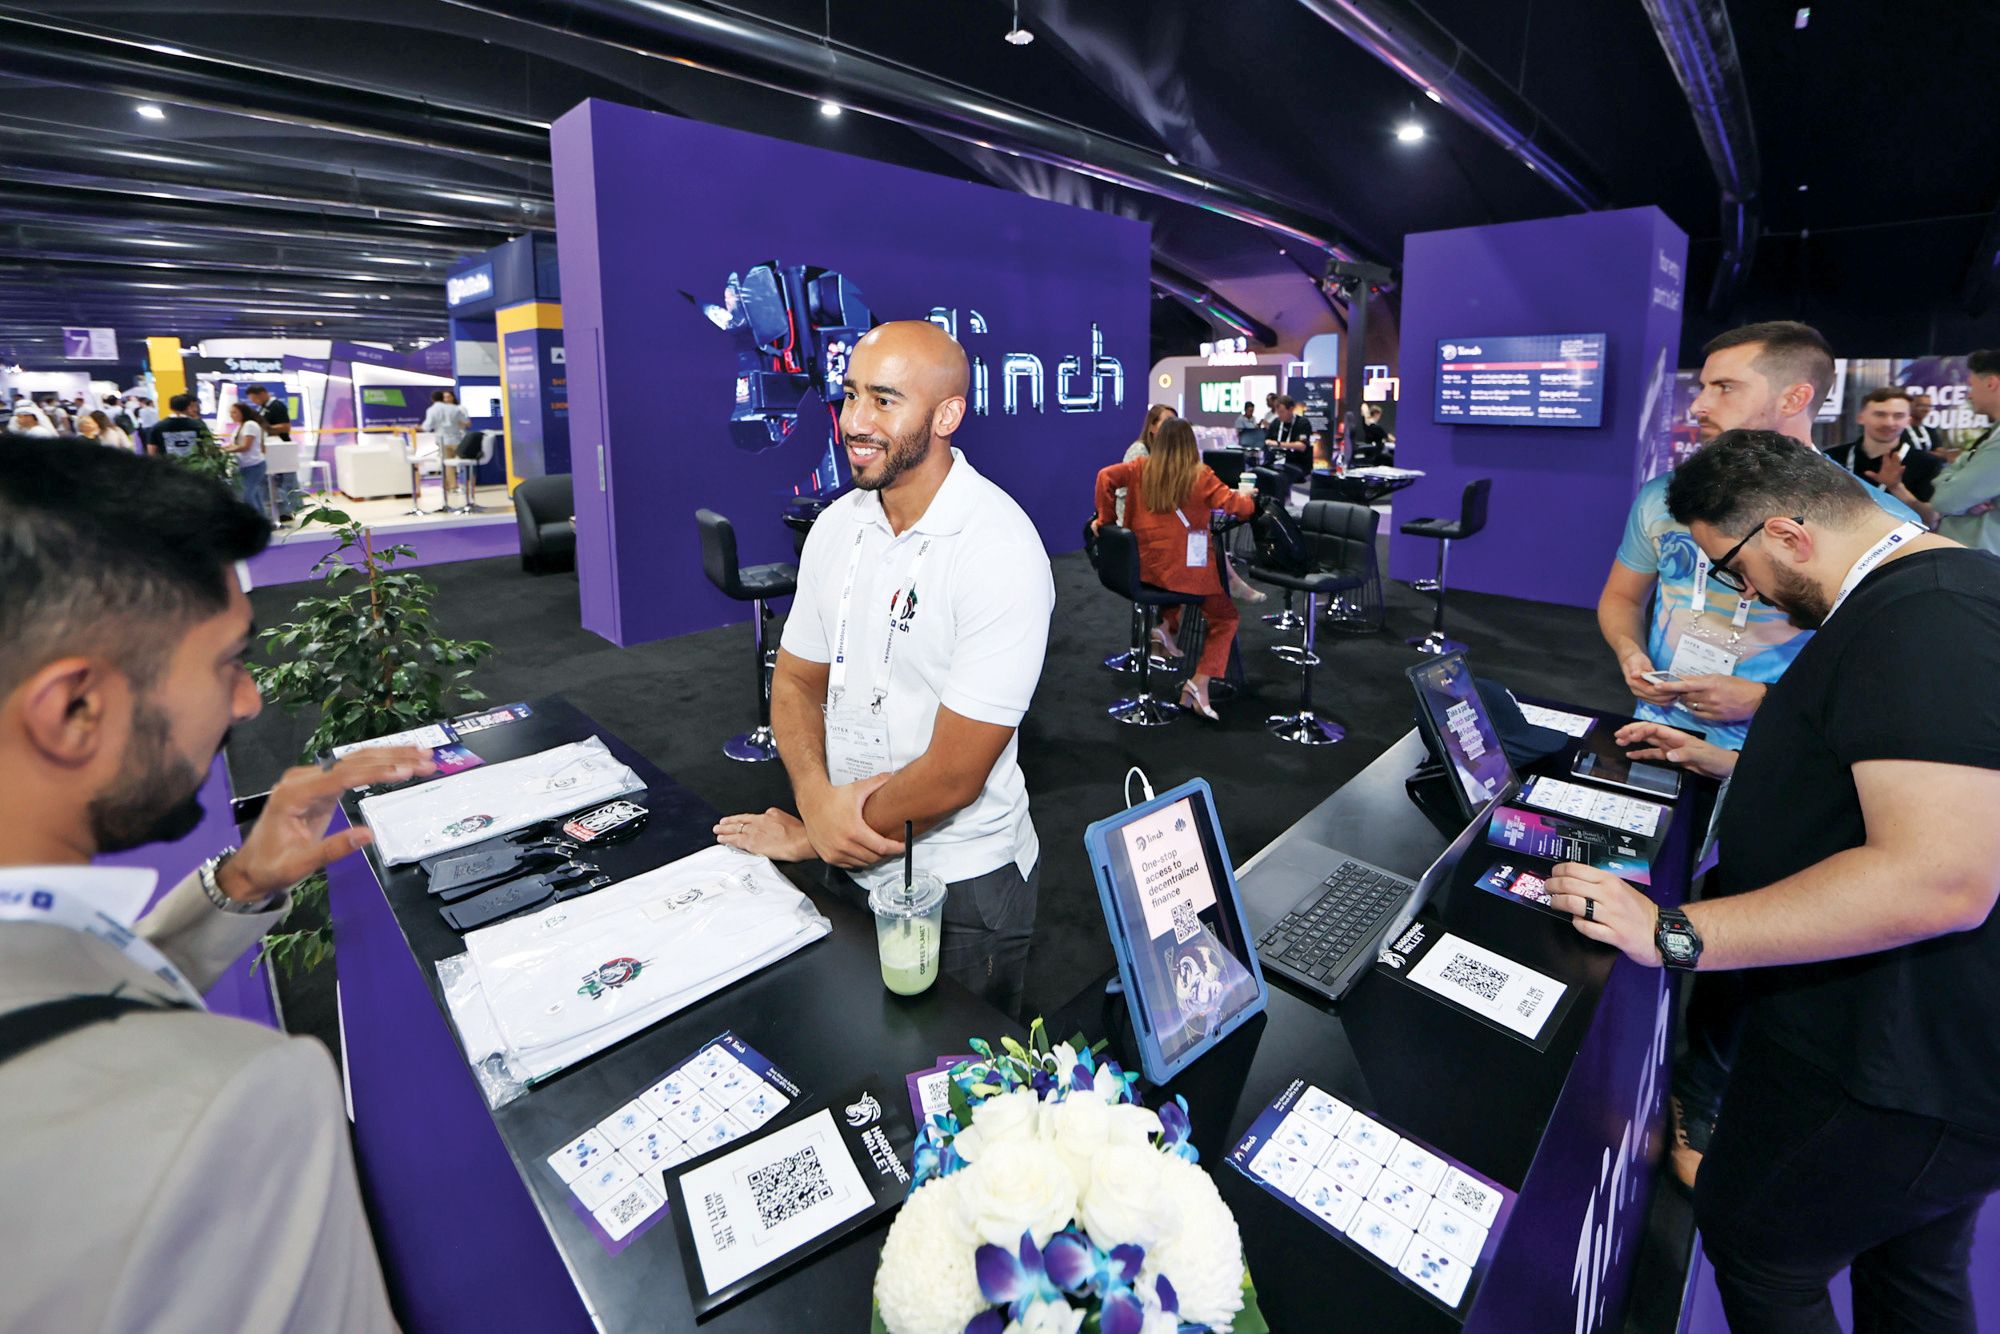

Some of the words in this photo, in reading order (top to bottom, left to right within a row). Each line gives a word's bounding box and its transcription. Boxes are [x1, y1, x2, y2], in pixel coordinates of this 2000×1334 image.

[74, 336, 89, 357] 7
[240, 359, 282, 373] Bitget
[1857, 541, 1893, 570] Fireblocks
[838, 619, 846, 655] Fireblocks
[1142, 849, 1178, 873] One-stop
[1146, 864, 1173, 885] access
[1173, 860, 1182, 870] to
[1148, 862, 1200, 897] decentralized
[1151, 887, 1181, 909] finance
[1393, 921, 1425, 951] HARDWARE
[1401, 931, 1426, 955] WALLET
[1517, 999, 1529, 1014] JOIN
[1526, 985, 1537, 998] THE
[1523, 989, 1545, 1018] WAITLIST
[861, 1129, 892, 1175] WALLET
[870, 1125, 911, 1184] HARDWARE
[704, 1193, 727, 1252] WAITLIST
[713, 1191, 728, 1220] JOIN
[723, 1225, 737, 1249] THE
